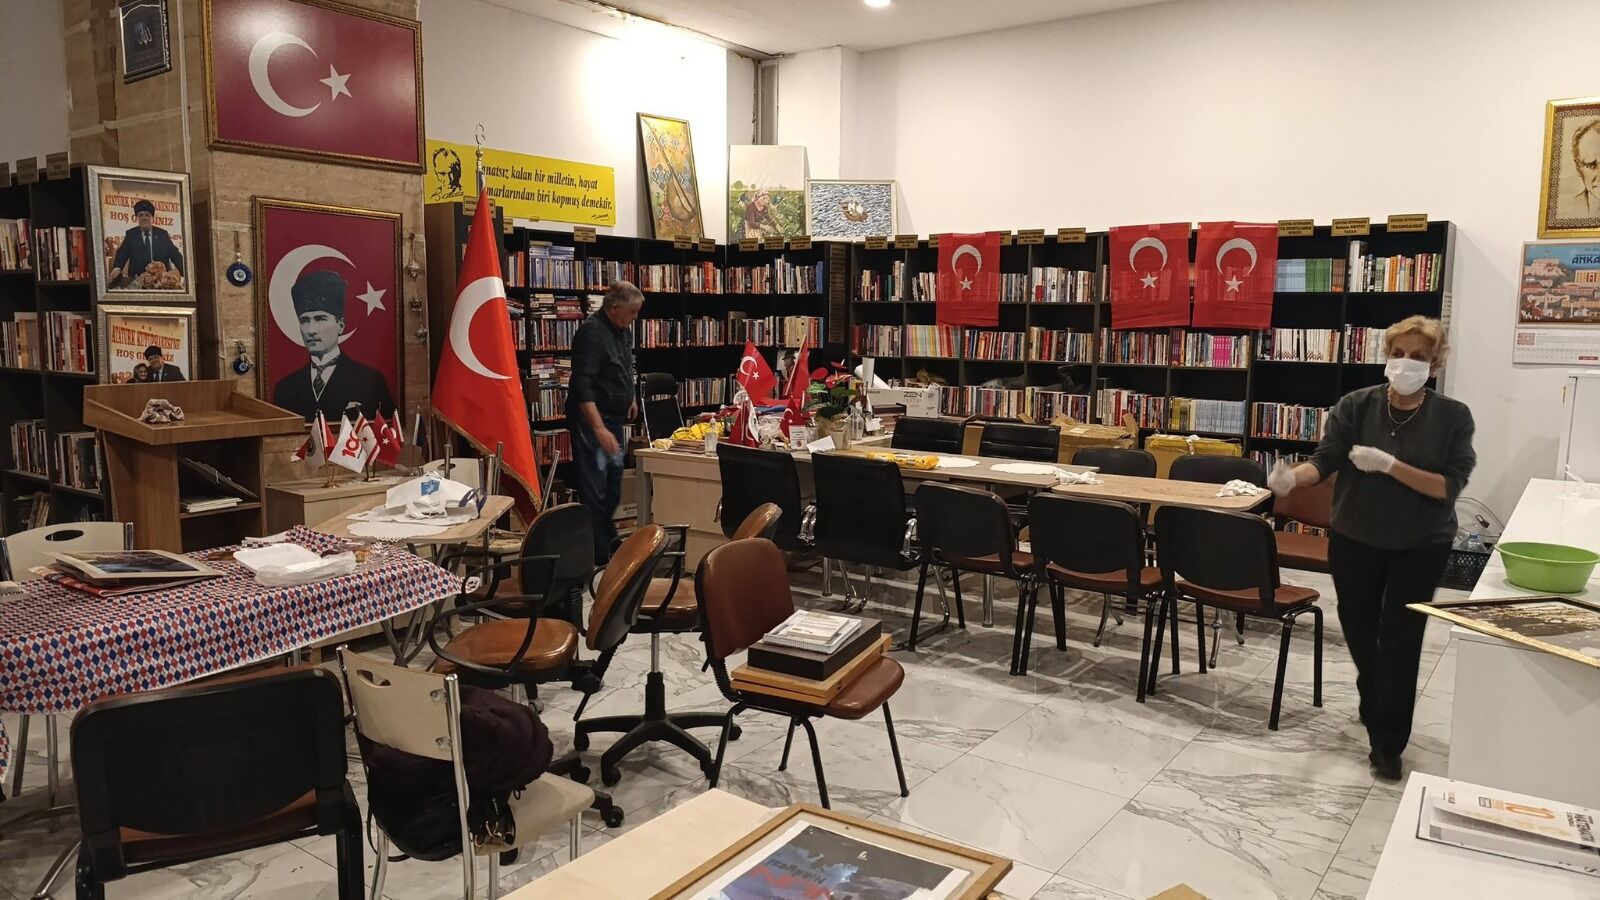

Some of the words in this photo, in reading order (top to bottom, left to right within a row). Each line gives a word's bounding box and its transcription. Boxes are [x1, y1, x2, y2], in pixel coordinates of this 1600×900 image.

[481, 165, 509, 179] anatsız
[511, 165, 533, 181] kalan
[534, 168, 546, 183] bir
[547, 171, 577, 188] milletin,
[578, 175, 598, 192] hayat
[486, 184, 535, 201] marlarından
[536, 189, 551, 203] biri
[551, 190, 580, 209] kopmuş
[581, 194, 612, 210] demektir.
[110, 211, 129, 224] HOŞ
[116, 349, 134, 360] HOŞ
